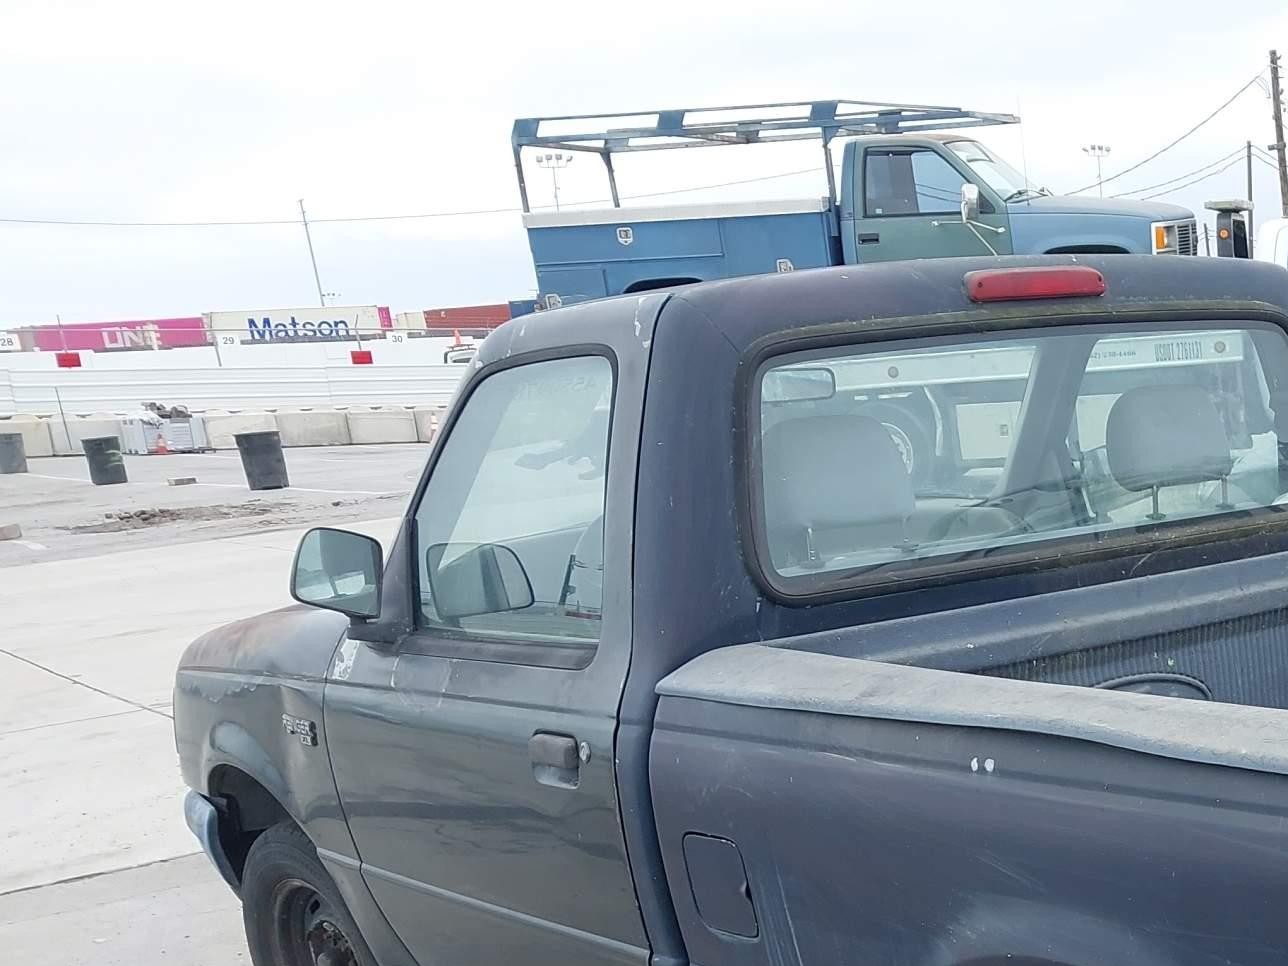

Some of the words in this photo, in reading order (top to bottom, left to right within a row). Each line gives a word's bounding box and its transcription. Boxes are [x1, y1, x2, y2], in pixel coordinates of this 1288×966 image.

[247, 316, 350, 341] Matson
[1, 337, 14, 347] 28
[222, 336, 235, 345] 29
[391, 335, 403, 344] 30
